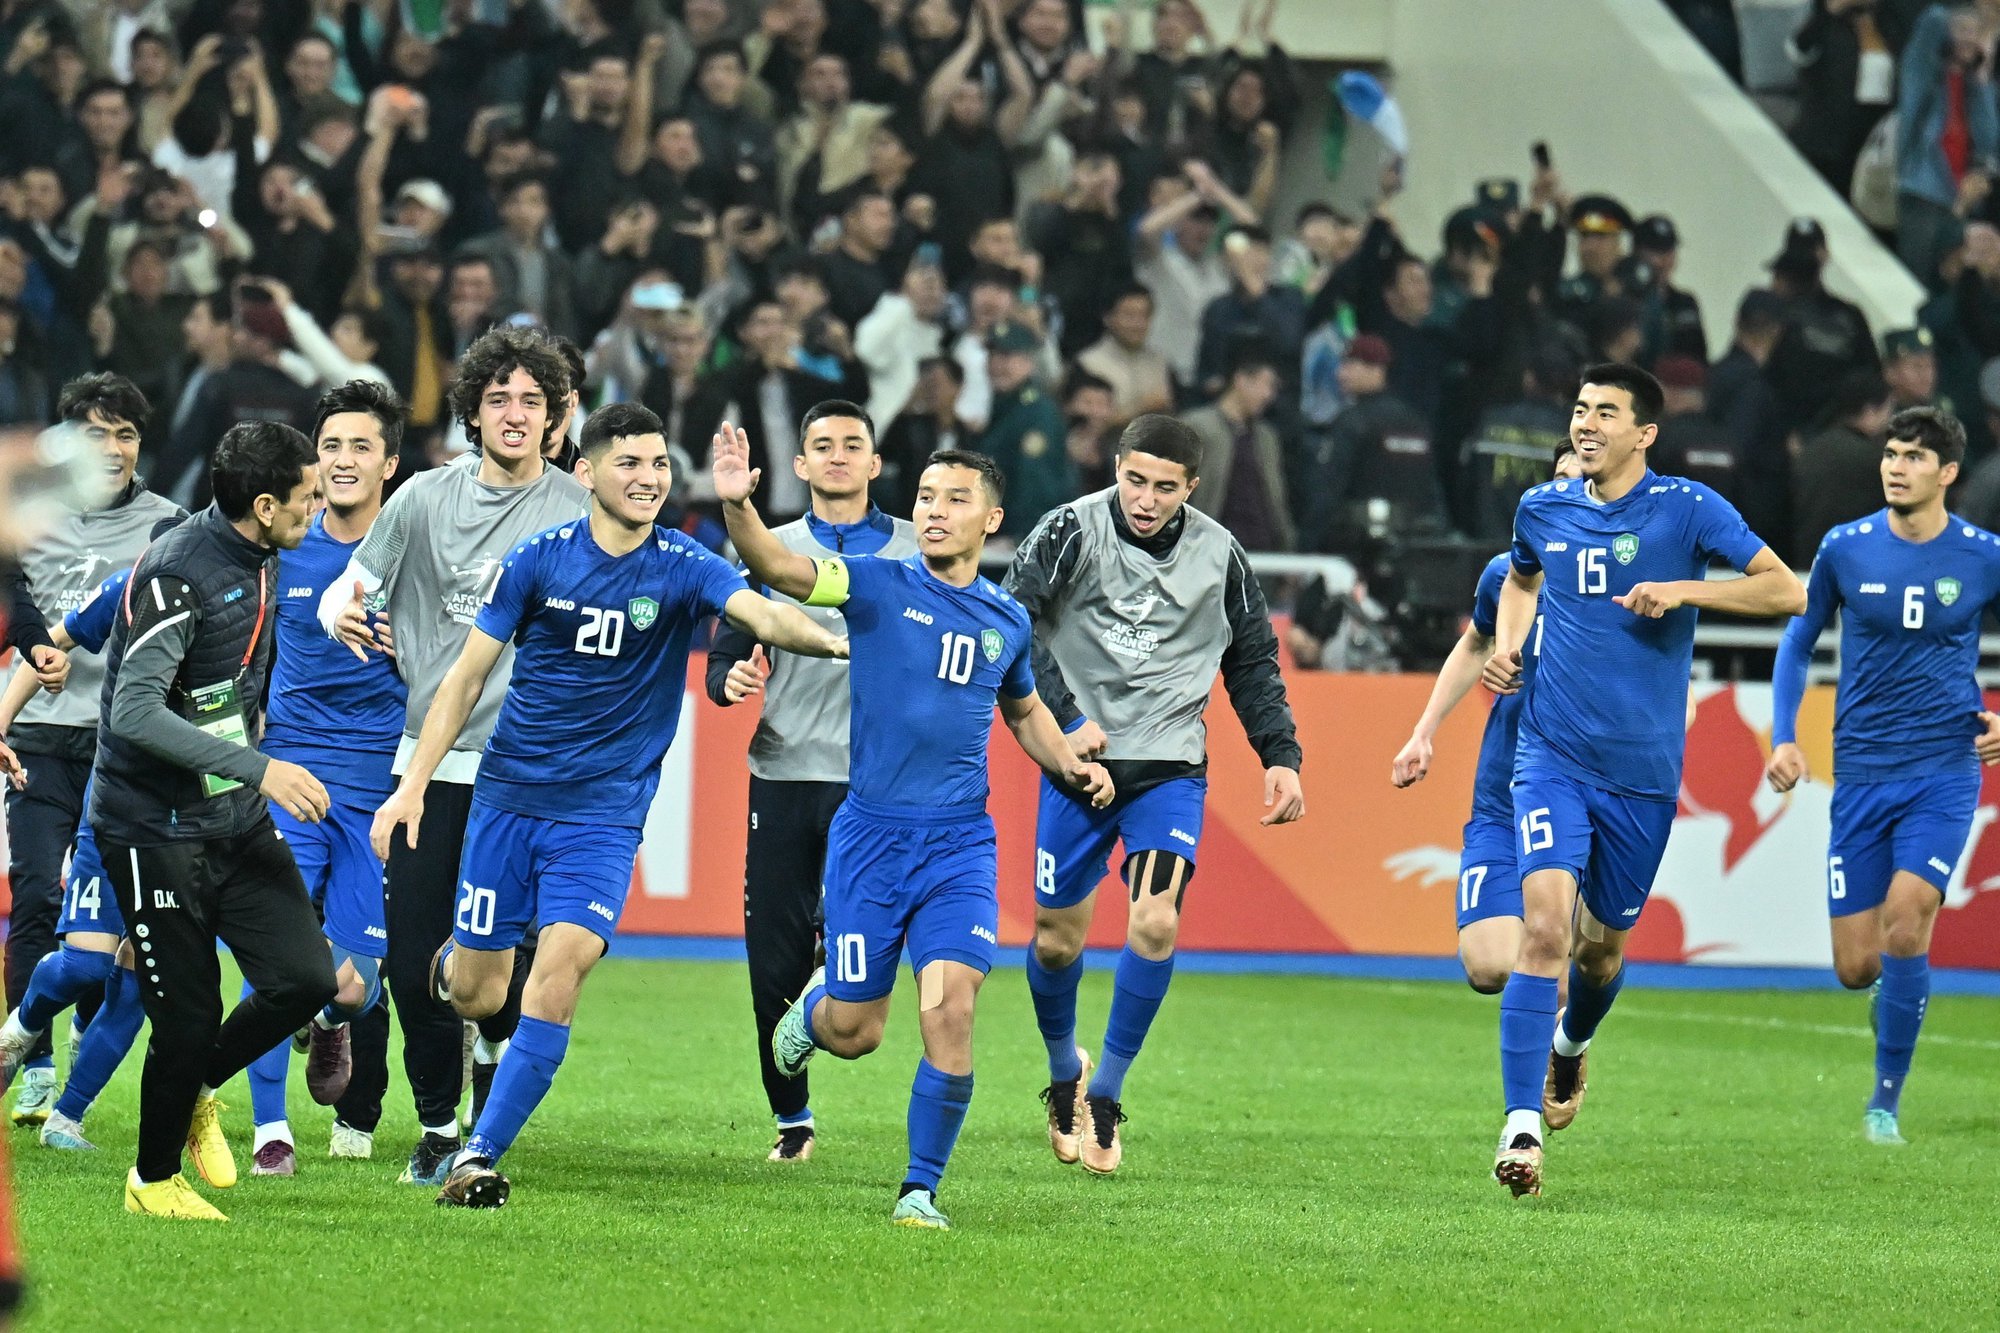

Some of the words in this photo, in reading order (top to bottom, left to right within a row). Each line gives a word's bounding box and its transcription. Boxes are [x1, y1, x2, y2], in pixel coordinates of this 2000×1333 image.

[1545, 542, 1568, 552] JAKO
[1615, 539, 1635, 552] UFA
[1577, 548, 1607, 594] 15
[61, 590, 82, 600] AFC
[287, 587, 313, 598] JAKO
[452, 593, 475, 606] AFC
[446, 602, 478, 618] ASIAN
[545, 597, 575, 611] JAKO
[631, 602, 655, 618] UFA
[1903, 586, 1925, 630] 6
[903, 607, 934, 625] JAKO
[575, 606, 625, 657] 20
[1101, 629, 1138, 649] ASIAN
[1137, 640, 1159, 652] CUP
[1112, 622, 1136, 636] AFC
[1135, 630, 1158, 643] U20
[984, 633, 1000, 652] UFA
[937, 631, 976, 685] 10
[751, 812, 758, 830] 9
[1169, 828, 1196, 846] JAKO
[1520, 807, 1554, 856] 15
[1036, 847, 1056, 895] 18
[1829, 856, 1846, 900] 6
[69, 876, 101, 920] 14
[153, 889, 180, 909] D.K.
[1461, 866, 1488, 912] 17
[456, 880, 497, 936] 20
[587, 901, 614, 921] JAKO
[970, 925, 996, 945] JAKO
[836, 933, 867, 982] 10
